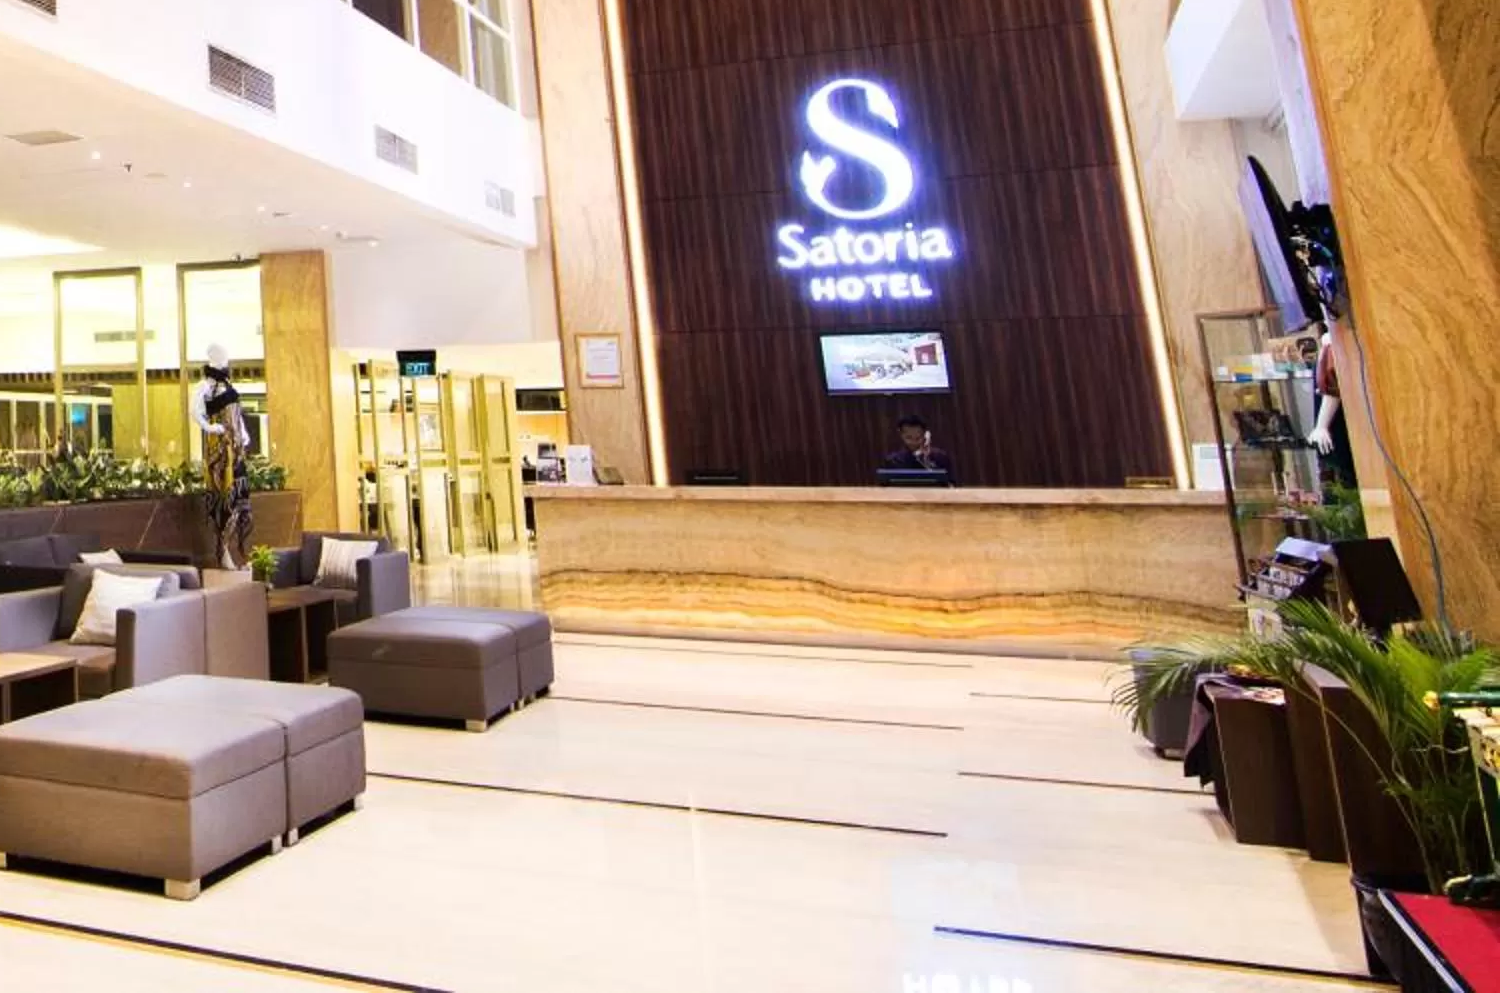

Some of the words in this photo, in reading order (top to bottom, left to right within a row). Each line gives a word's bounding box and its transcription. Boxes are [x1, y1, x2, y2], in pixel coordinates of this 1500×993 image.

[776, 222, 953, 270] Satoria
[810, 273, 933, 302] HOTEL
[405, 362, 431, 376] EXIT
